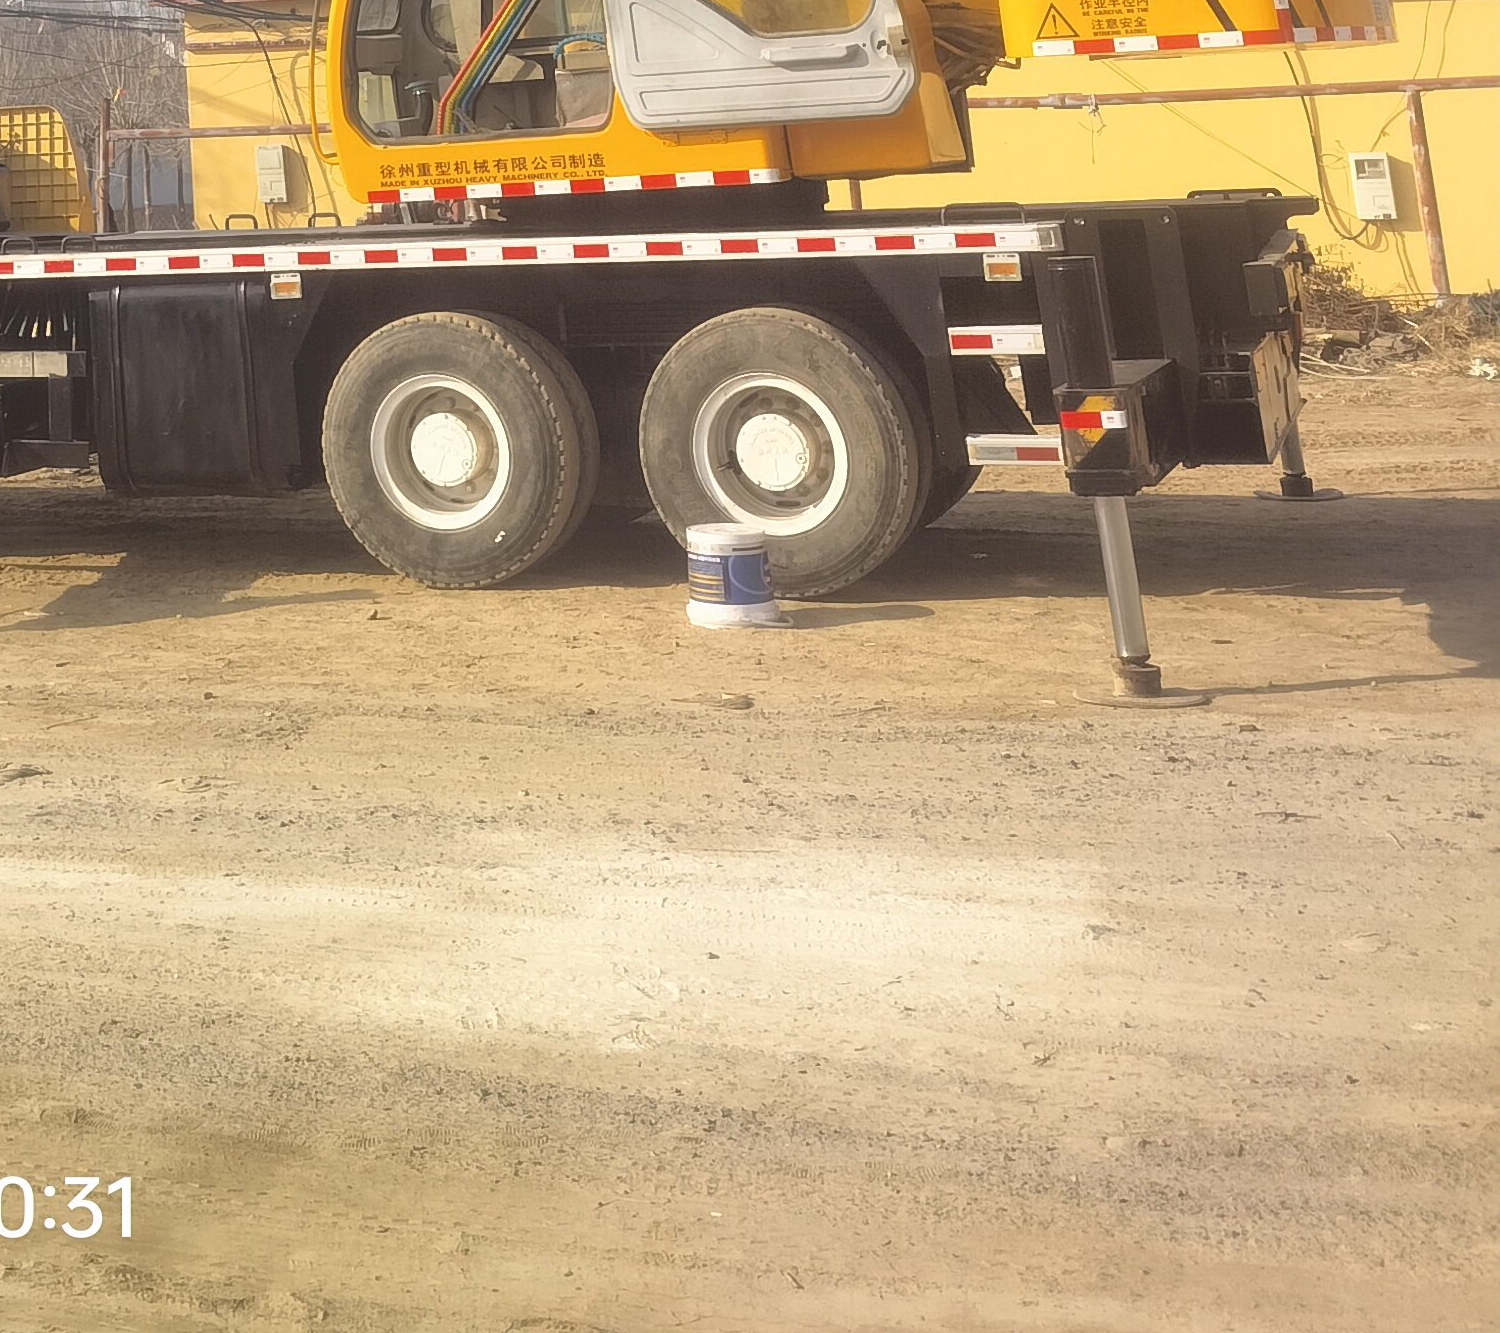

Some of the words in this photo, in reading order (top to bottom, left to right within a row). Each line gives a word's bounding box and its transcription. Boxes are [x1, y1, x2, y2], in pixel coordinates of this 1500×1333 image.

[1091, 16, 1147, 30] 注意安全
[379, 152, 607, 180] 徐州重型机械有限公司制造
[380, 180, 407, 188] MADE
[410, 179, 420, 187] IN
[423, 177, 462, 186] XUZHOU
[466, 175, 498, 183] HEAVY
[502, 171, 559, 181] MACHINERY
